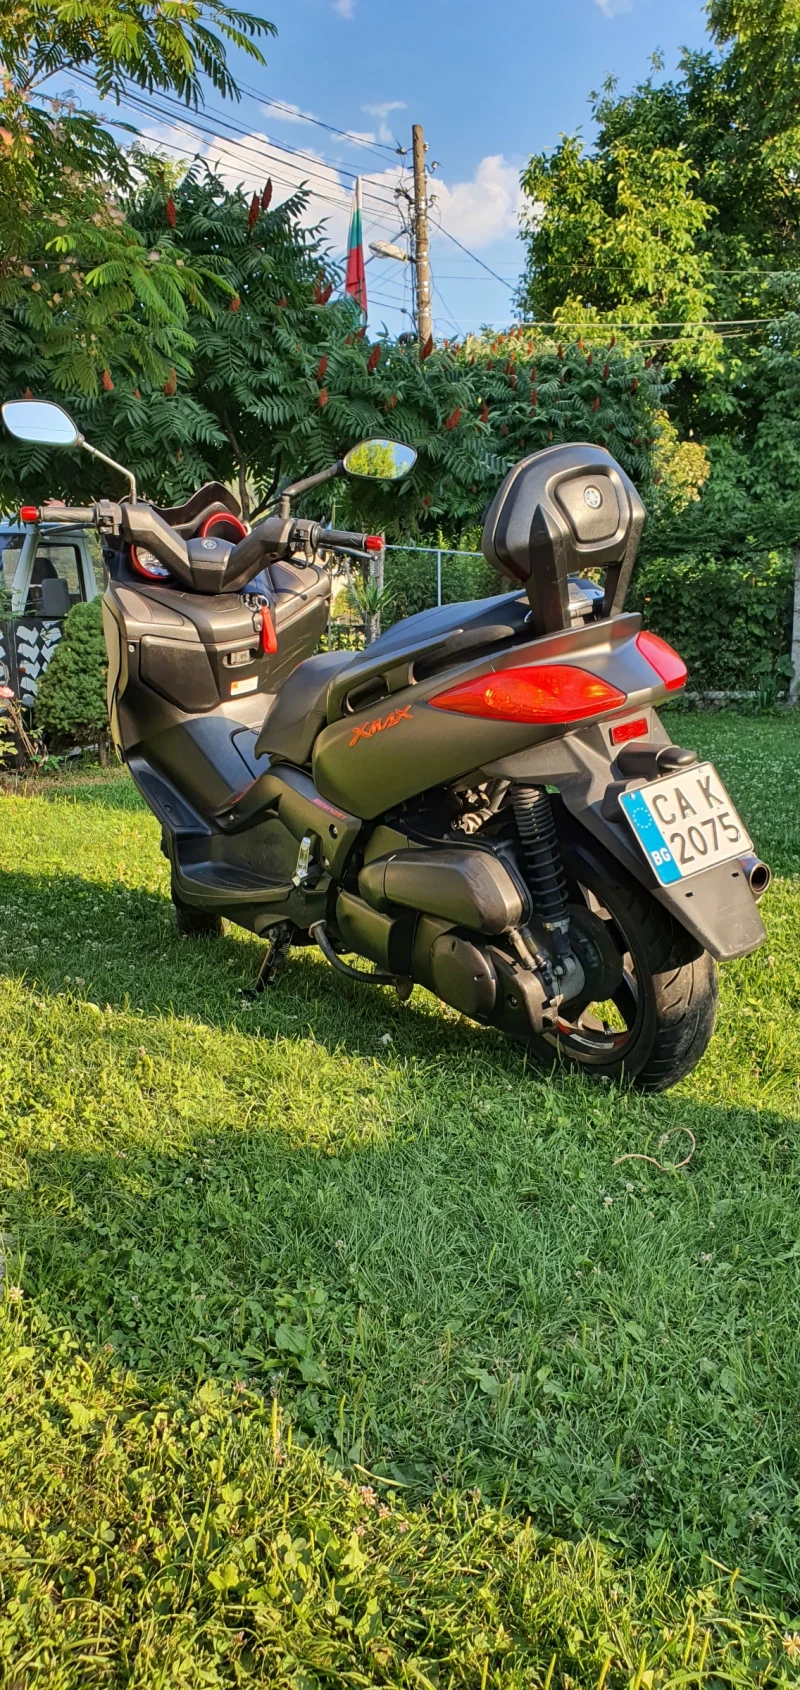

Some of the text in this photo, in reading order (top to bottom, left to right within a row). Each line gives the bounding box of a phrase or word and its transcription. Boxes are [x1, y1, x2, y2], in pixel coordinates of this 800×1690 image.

[349, 704, 413, 747] XMAX
[652, 775, 724, 825] CA K
[650, 847, 672, 867] BG
[670, 812, 740, 865] 2075
